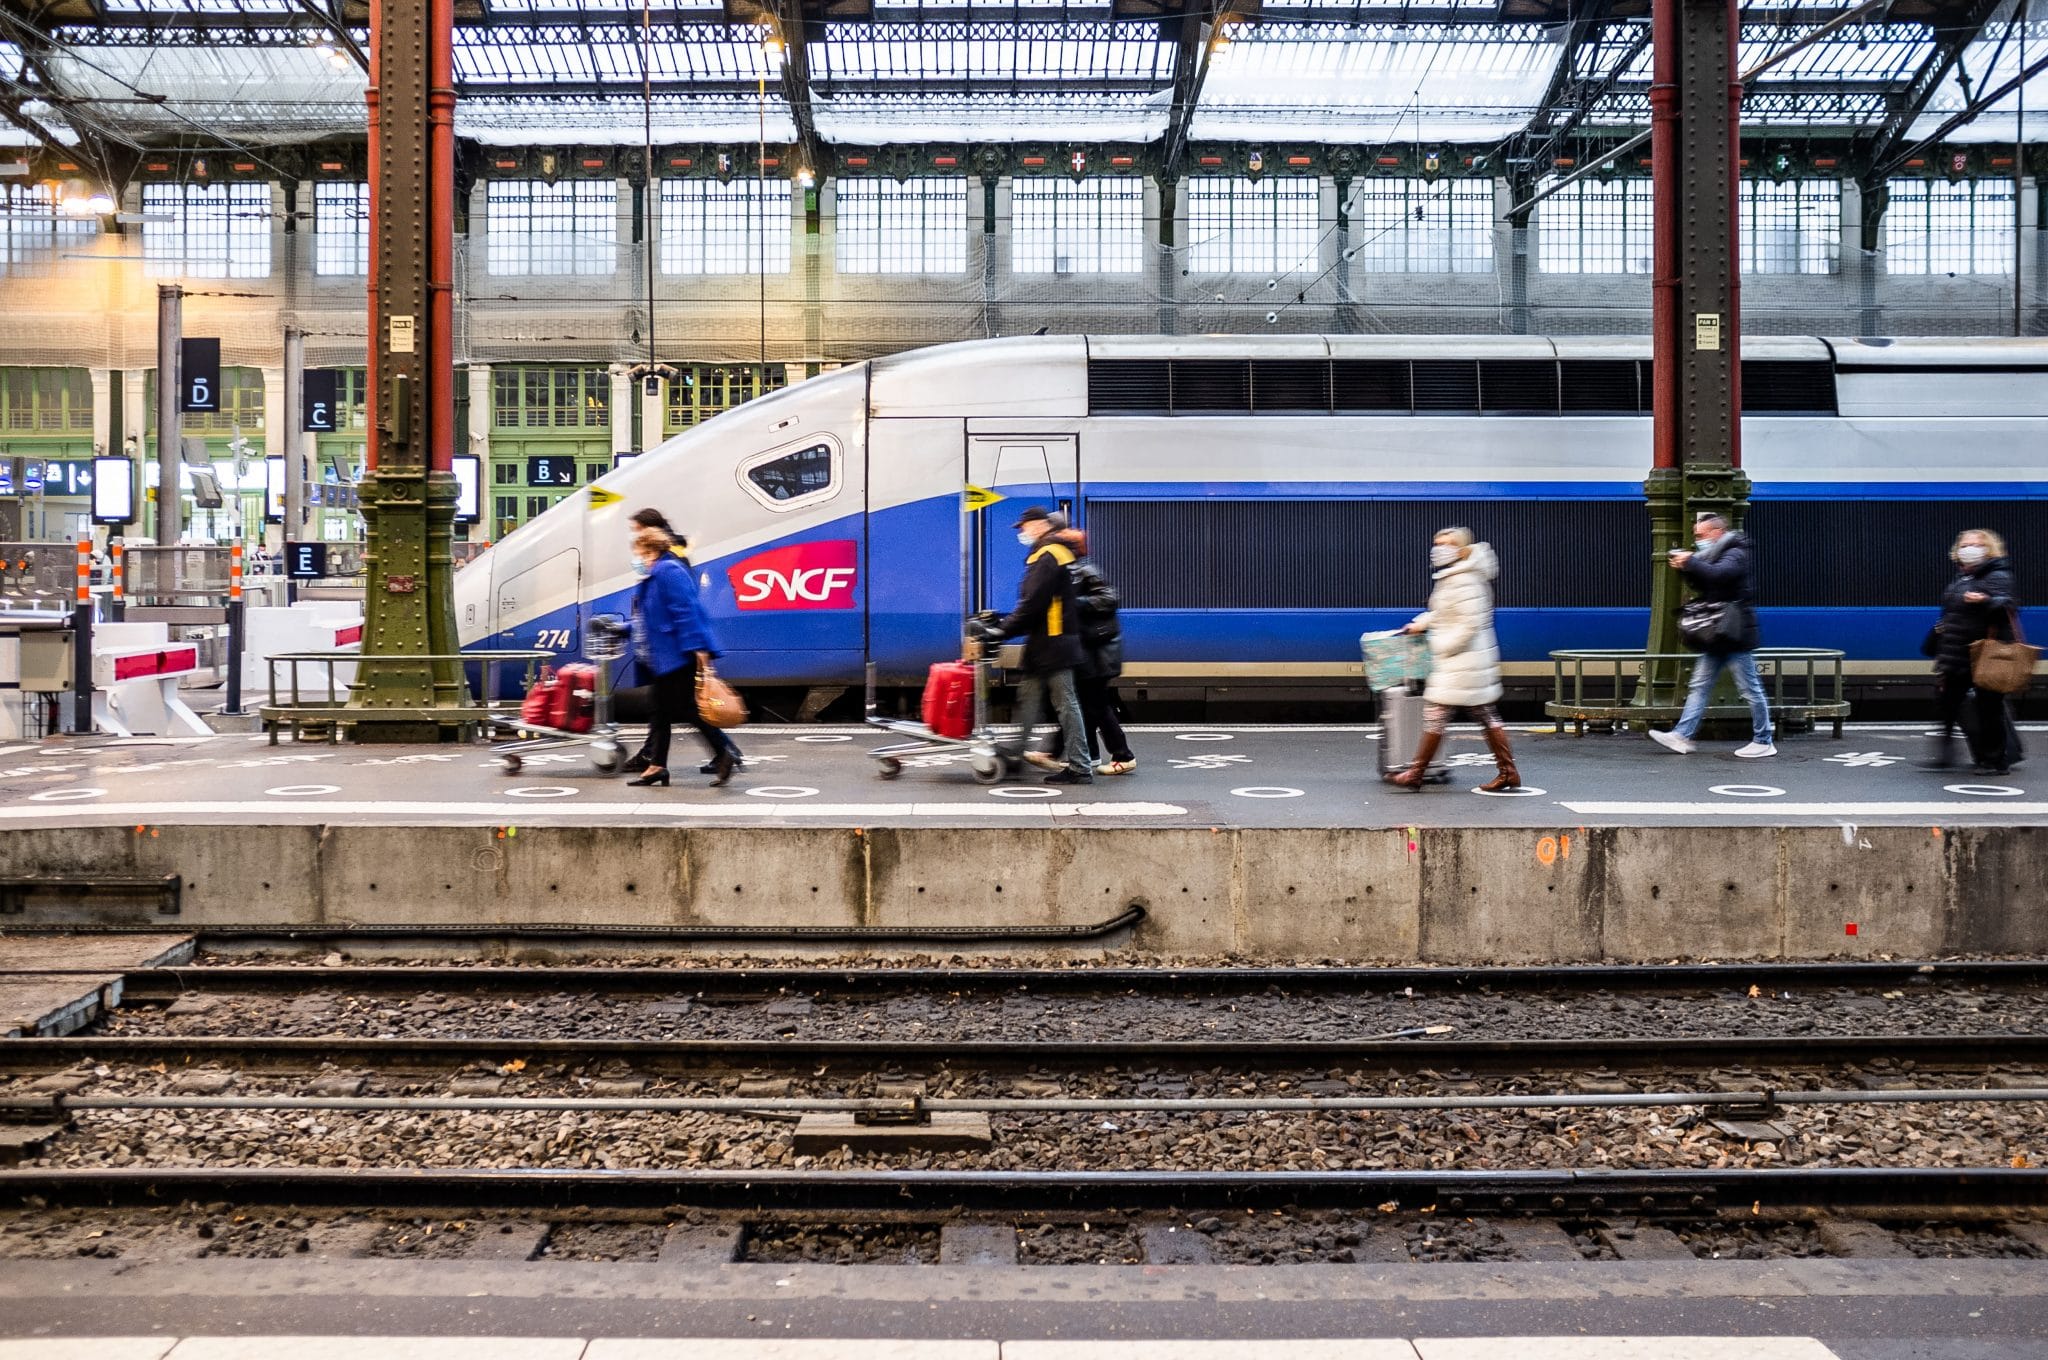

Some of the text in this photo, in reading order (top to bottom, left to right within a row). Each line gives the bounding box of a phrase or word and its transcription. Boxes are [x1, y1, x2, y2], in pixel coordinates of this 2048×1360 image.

[192, 384, 209, 404] D
[312, 408, 327, 425] C
[538, 465, 550, 480] B
[299, 553, 313, 571] E
[738, 567, 855, 602] SNCF
[533, 629, 571, 649] 274
